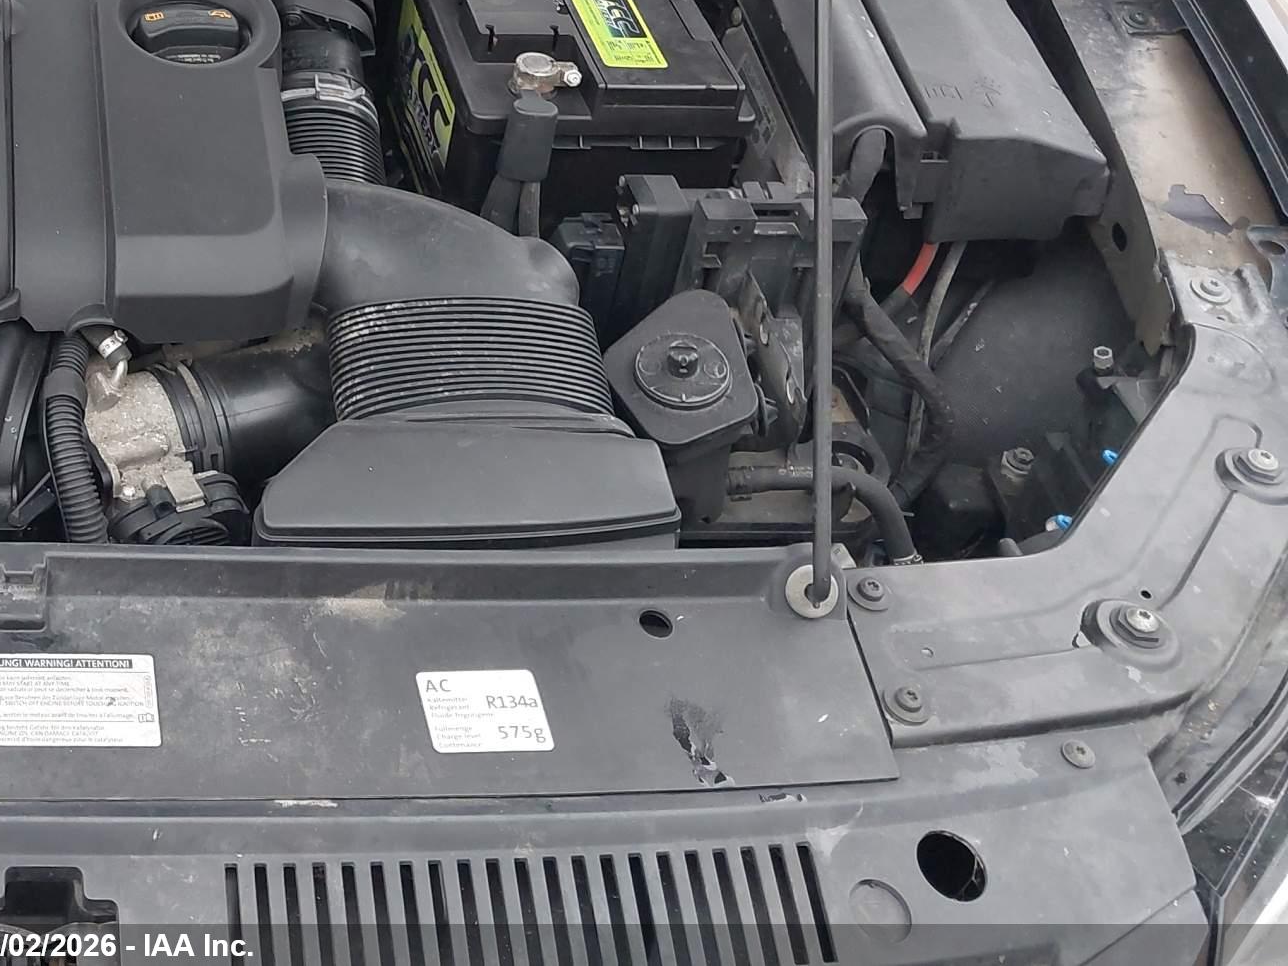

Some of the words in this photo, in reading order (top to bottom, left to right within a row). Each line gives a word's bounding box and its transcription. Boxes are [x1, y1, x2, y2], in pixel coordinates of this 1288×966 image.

[24, 659, 73, 668] WARNING!
[75, 660, 130, 669] ATTENTION!
[486, 695, 539, 709] R134a
[498, 725, 546, 744] 575g
